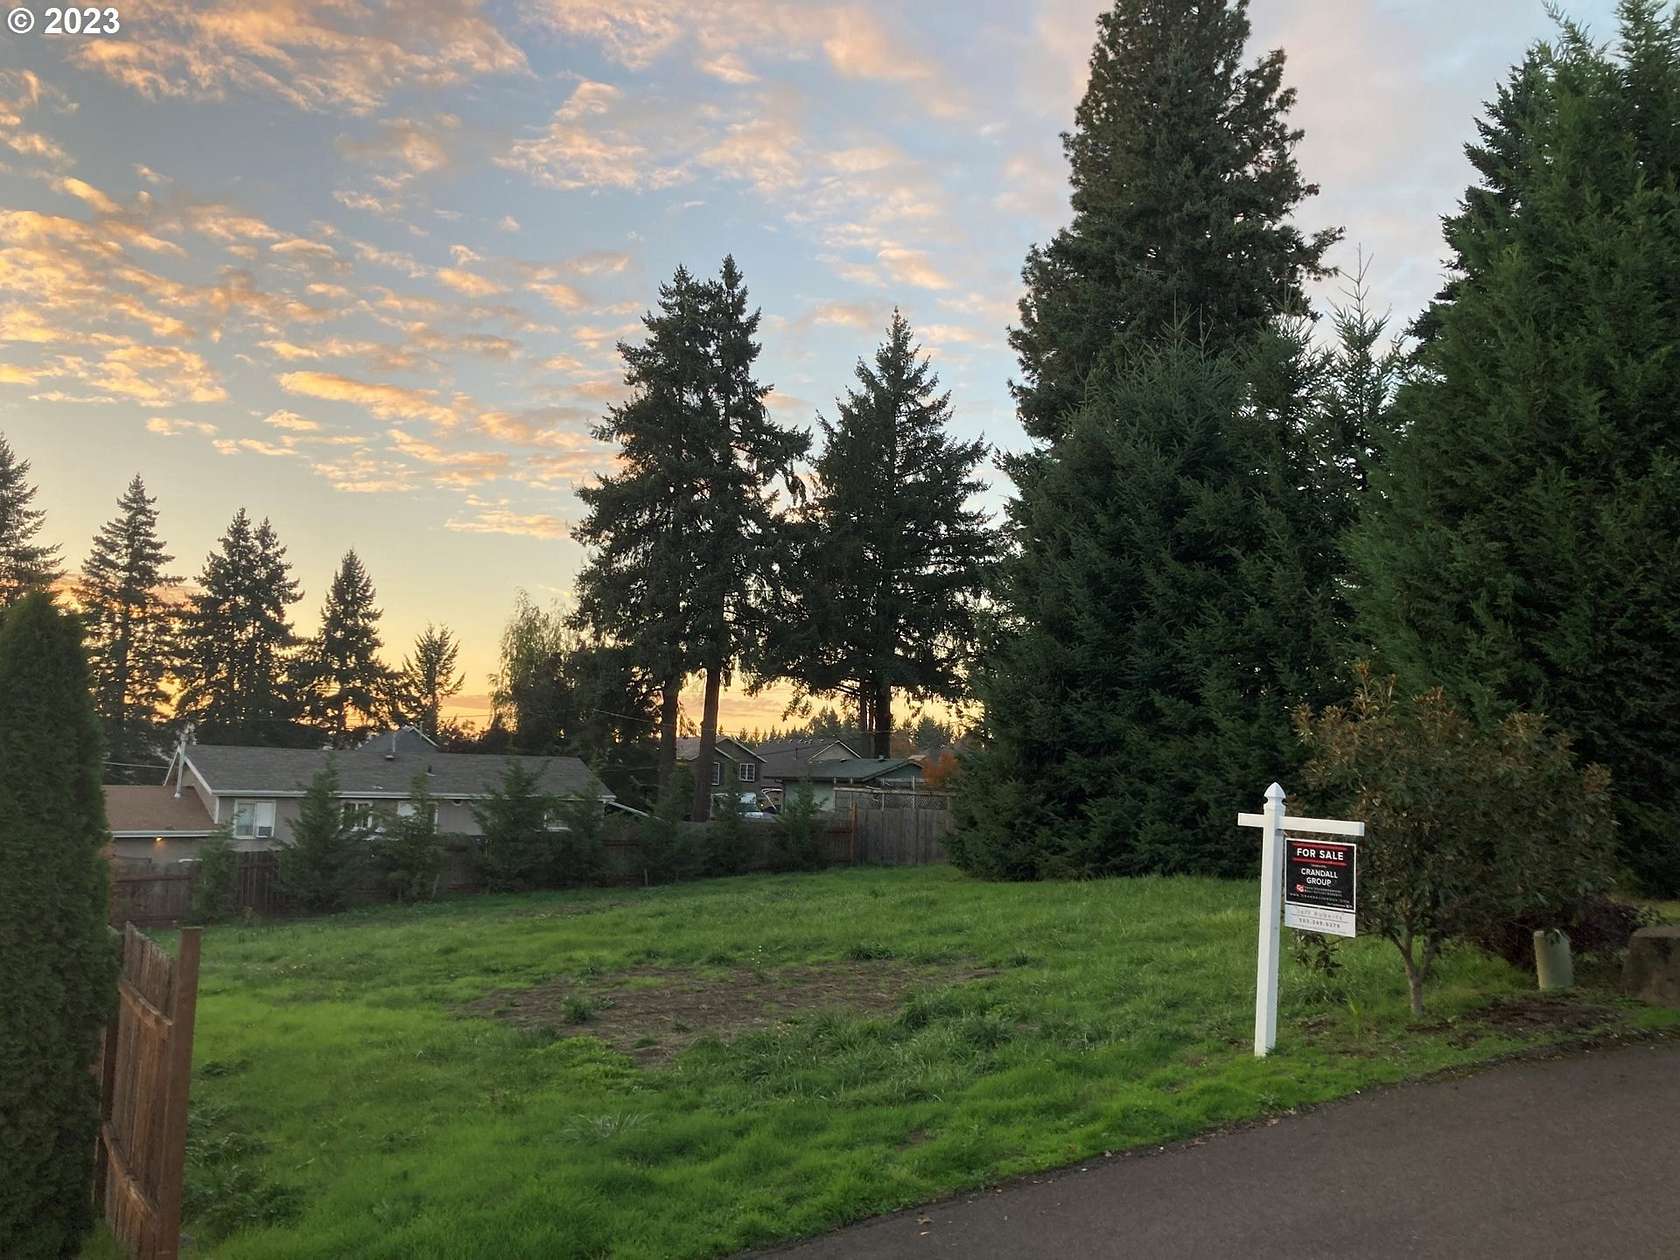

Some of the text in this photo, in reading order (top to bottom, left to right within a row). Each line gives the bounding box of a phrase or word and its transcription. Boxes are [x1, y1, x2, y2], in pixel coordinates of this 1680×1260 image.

[1296, 848, 1344, 861] FOR SALE
[1301, 868, 1338, 879] CRANDALL
[1306, 877, 1332, 886] GROUP
